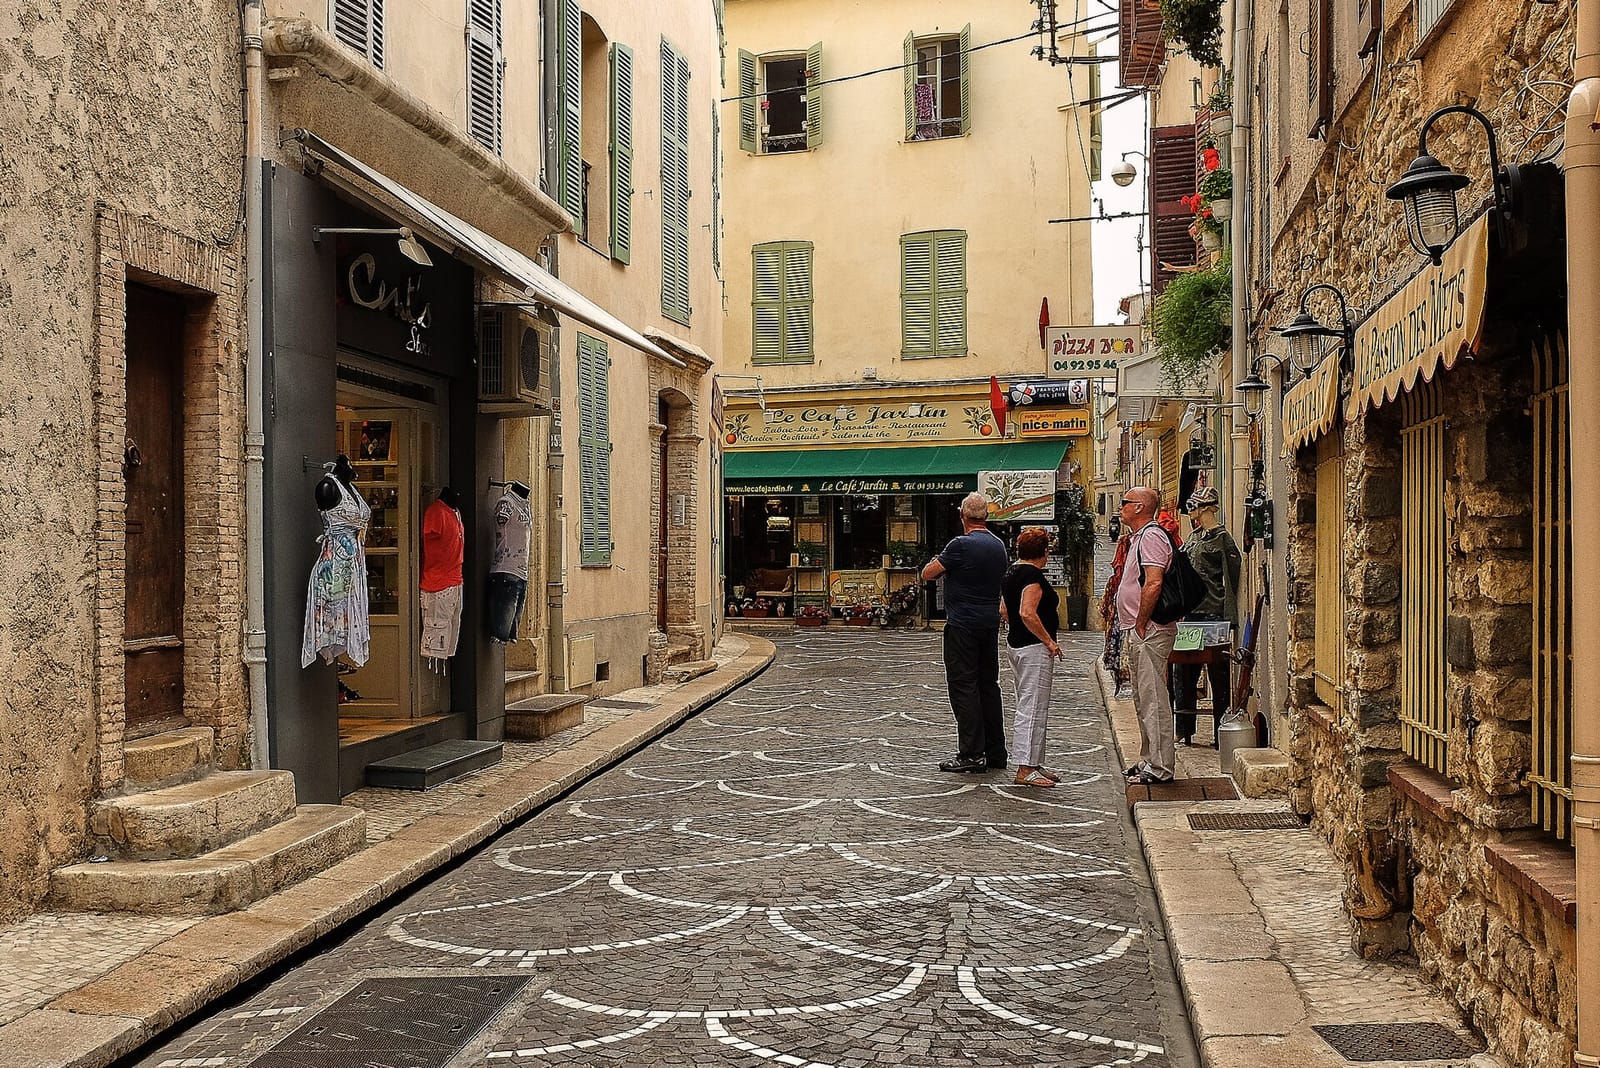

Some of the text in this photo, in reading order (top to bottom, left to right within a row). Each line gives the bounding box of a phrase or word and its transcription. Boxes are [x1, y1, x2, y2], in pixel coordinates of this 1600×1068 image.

[1371, 326, 1406, 381] PASSION
[1408, 299, 1427, 361] DES
[1430, 270, 1465, 348] METS
[1053, 332, 1096, 355] PIZZA
[1053, 359, 1118, 371] 04 92 95 46
[766, 408, 796, 425] Le
[832, 423, 879, 432] Brasserie
[888, 421, 948, 430] Restaurant
[743, 433, 773, 444] Glacier
[780, 433, 820, 442] Cocktails
[831, 431, 860, 440] Salon
[862, 430, 873, 438] de
[907, 428, 942, 439] Jardin
[819, 481, 833, 491] Le
[835, 479, 857, 495] Café
[857, 478, 889, 493] Jardin
